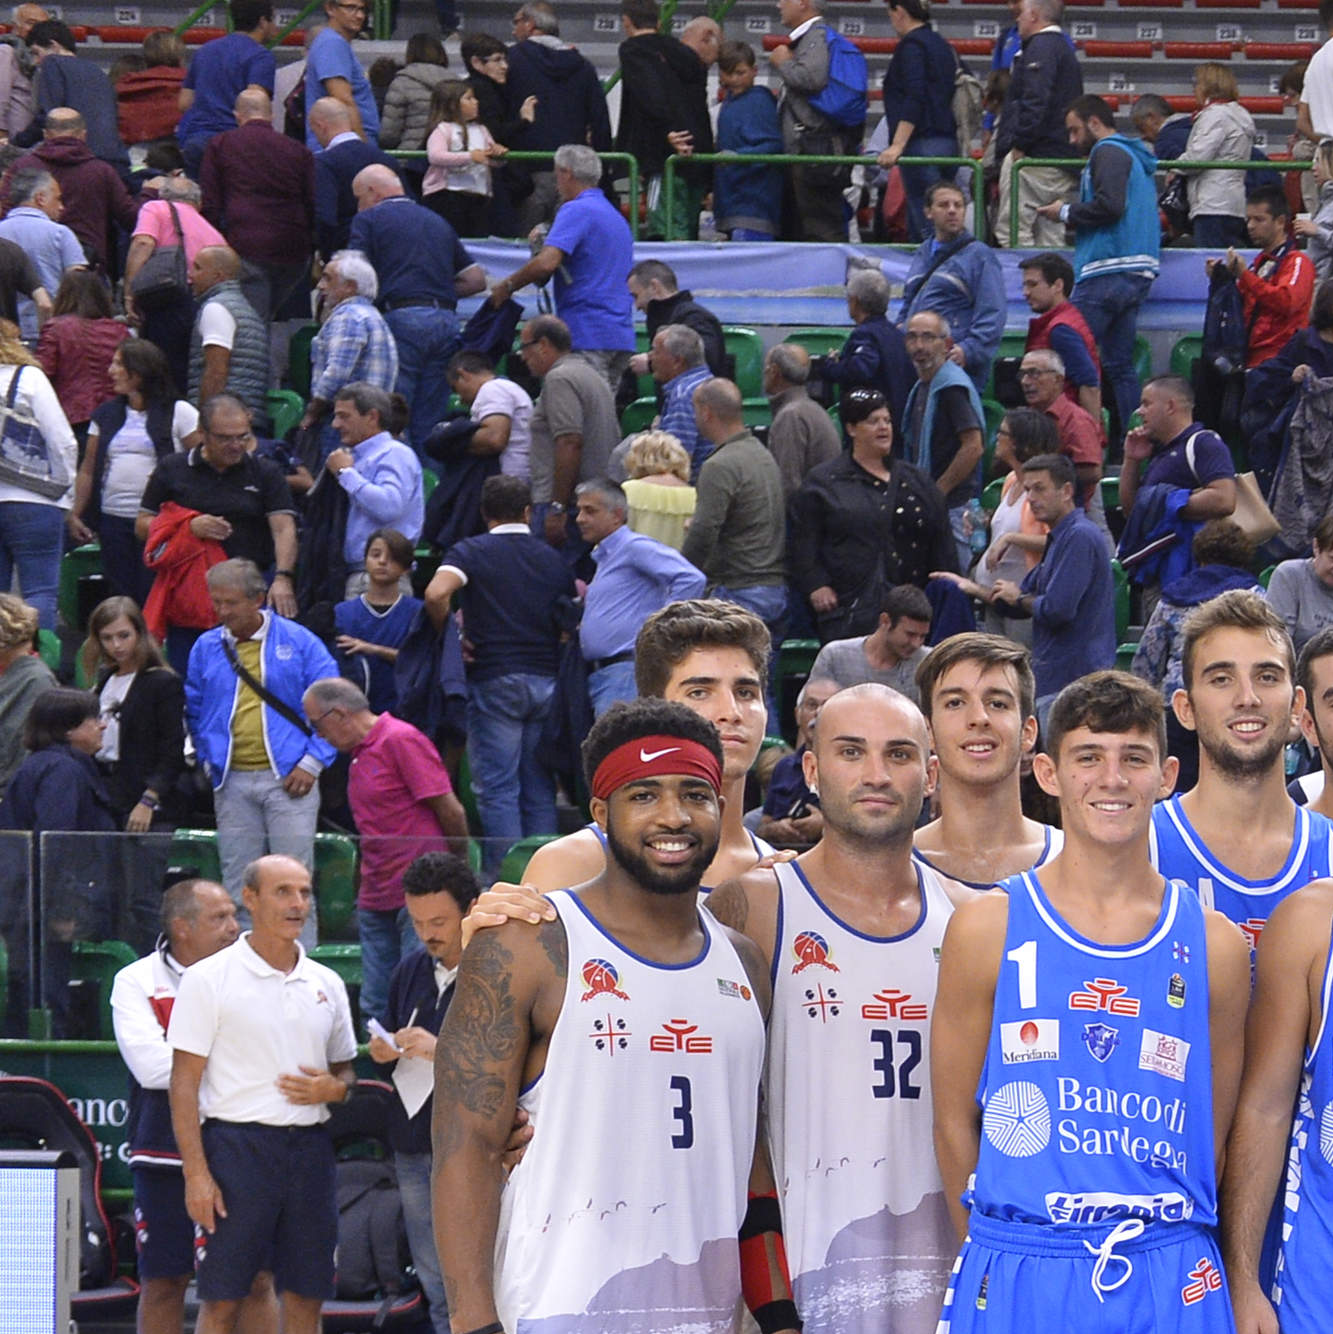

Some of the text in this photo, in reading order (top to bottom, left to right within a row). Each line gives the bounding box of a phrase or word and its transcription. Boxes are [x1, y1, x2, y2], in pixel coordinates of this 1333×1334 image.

[1007, 941, 1037, 1009] 1
[870, 1029, 922, 1099] 32
[1003, 1050, 1058, 1063] Meridiana
[670, 1075, 694, 1150] 3
[1057, 1077, 1187, 1134] Banco di
